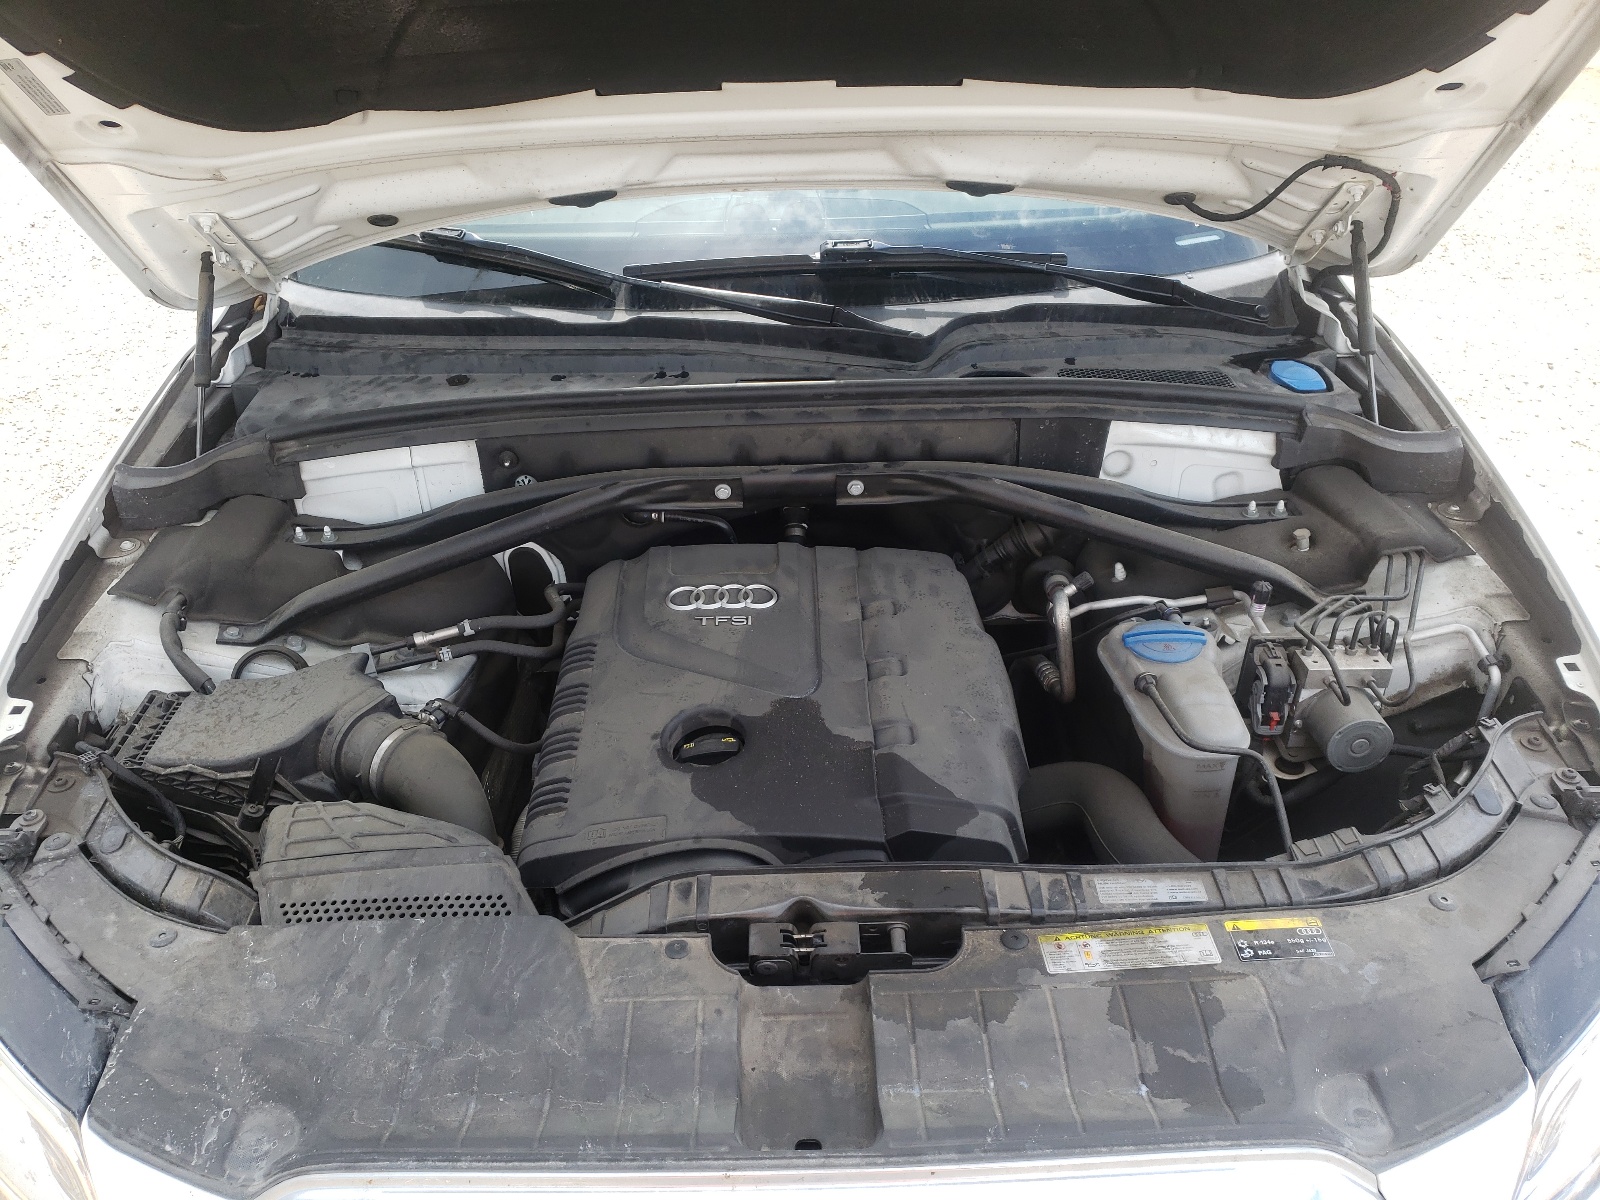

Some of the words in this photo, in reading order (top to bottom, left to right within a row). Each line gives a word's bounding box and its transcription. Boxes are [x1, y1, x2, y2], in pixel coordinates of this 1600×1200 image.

[694, 615, 753, 626] TFSI
[1105, 929, 1146, 937] WARNING
[1148, 926, 1191, 935] ATTENTION
